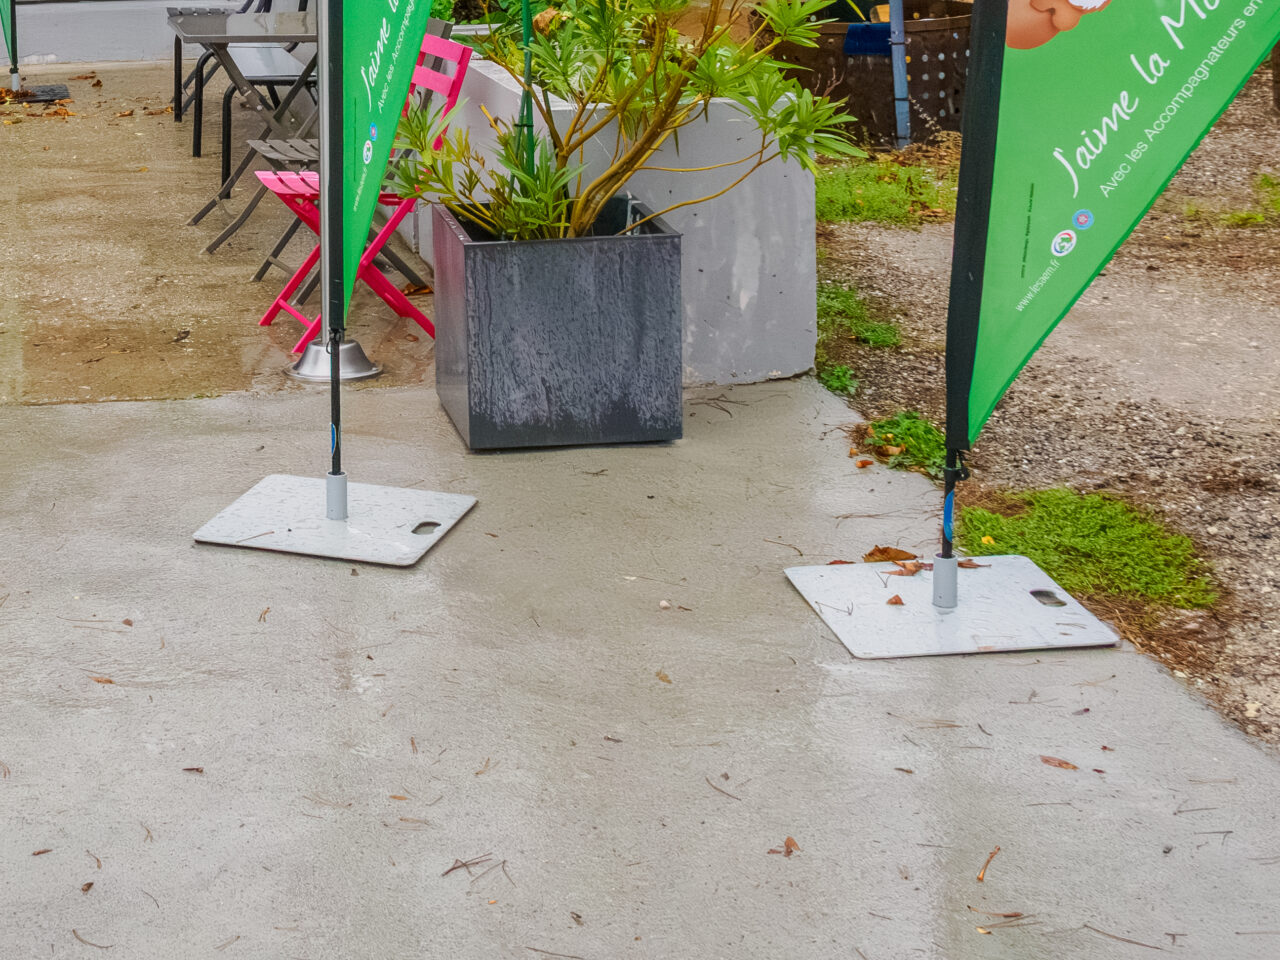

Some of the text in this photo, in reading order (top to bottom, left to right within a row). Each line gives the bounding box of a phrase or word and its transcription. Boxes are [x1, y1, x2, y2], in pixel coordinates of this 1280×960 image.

[378, 82, 390, 114] Avec
[1052, 90, 1139, 199] J'aime
[1130, 53, 1170, 84] la
[1099, 162, 1132, 198] Avec
[1124, 141, 1148, 163] les
[1144, 18, 1246, 142] Accompagnateurs
